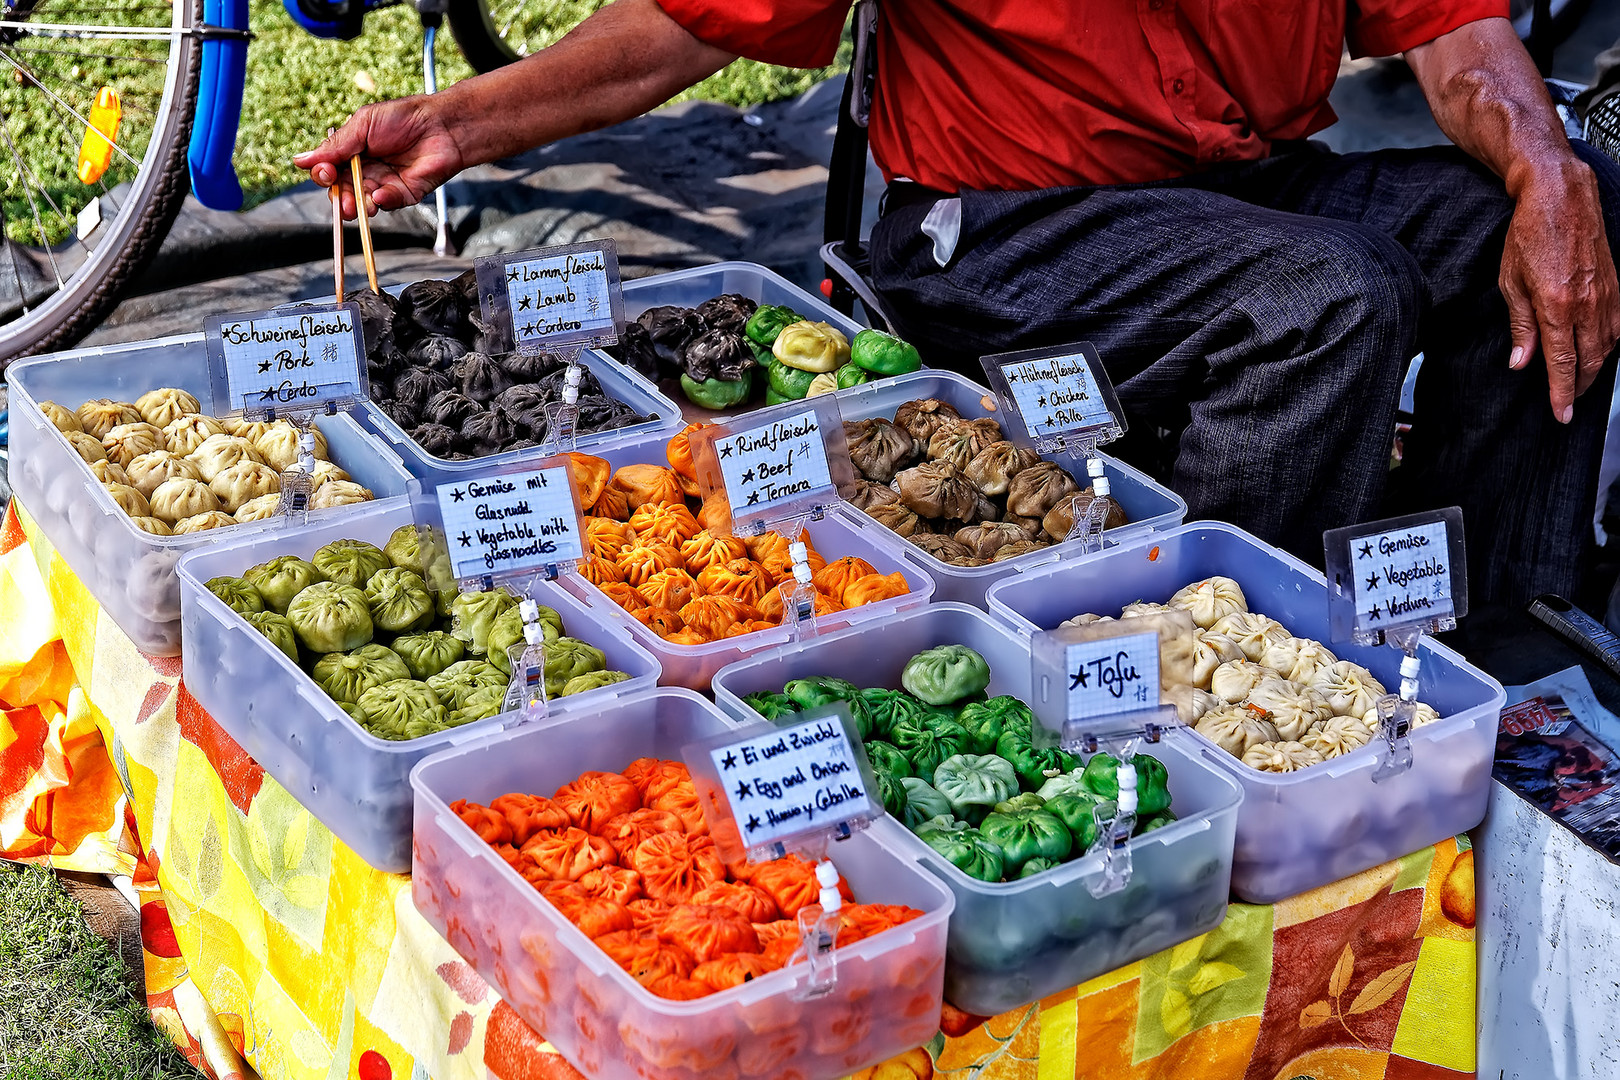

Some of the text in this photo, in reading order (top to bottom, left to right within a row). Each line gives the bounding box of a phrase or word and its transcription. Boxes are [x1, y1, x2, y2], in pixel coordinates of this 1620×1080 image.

[523, 256, 606, 283] Lammfleisch
[536, 286, 576, 310] Lamb
[228, 315, 353, 348] Schweinefleisch
[536, 317, 582, 335] Cordero
[274, 349, 314, 372] Pork
[1017, 360, 1085, 384] Hühnerfleisch
[276, 380, 317, 402] Cerdo
[1050, 387, 1089, 407] Chicken
[736, 417, 819, 456] Rindfleisch
[757, 449, 794, 480] Beef
[468, 472, 548, 498] Gemüse mit
[760, 479, 811, 502] Ternera
[475, 517, 569, 550] Vegetable with
[1378, 533, 1430, 557] Gemüse
[1383, 556, 1447, 587] Vegetable
[1087, 651, 1141, 698] Tofu
[741, 746, 759, 765] Ei
[761, 737, 790, 760] und
[754, 760, 851, 799] Egg and Onion
[802, 803, 813, 821] y
[815, 783, 864, 811] Cebolla
